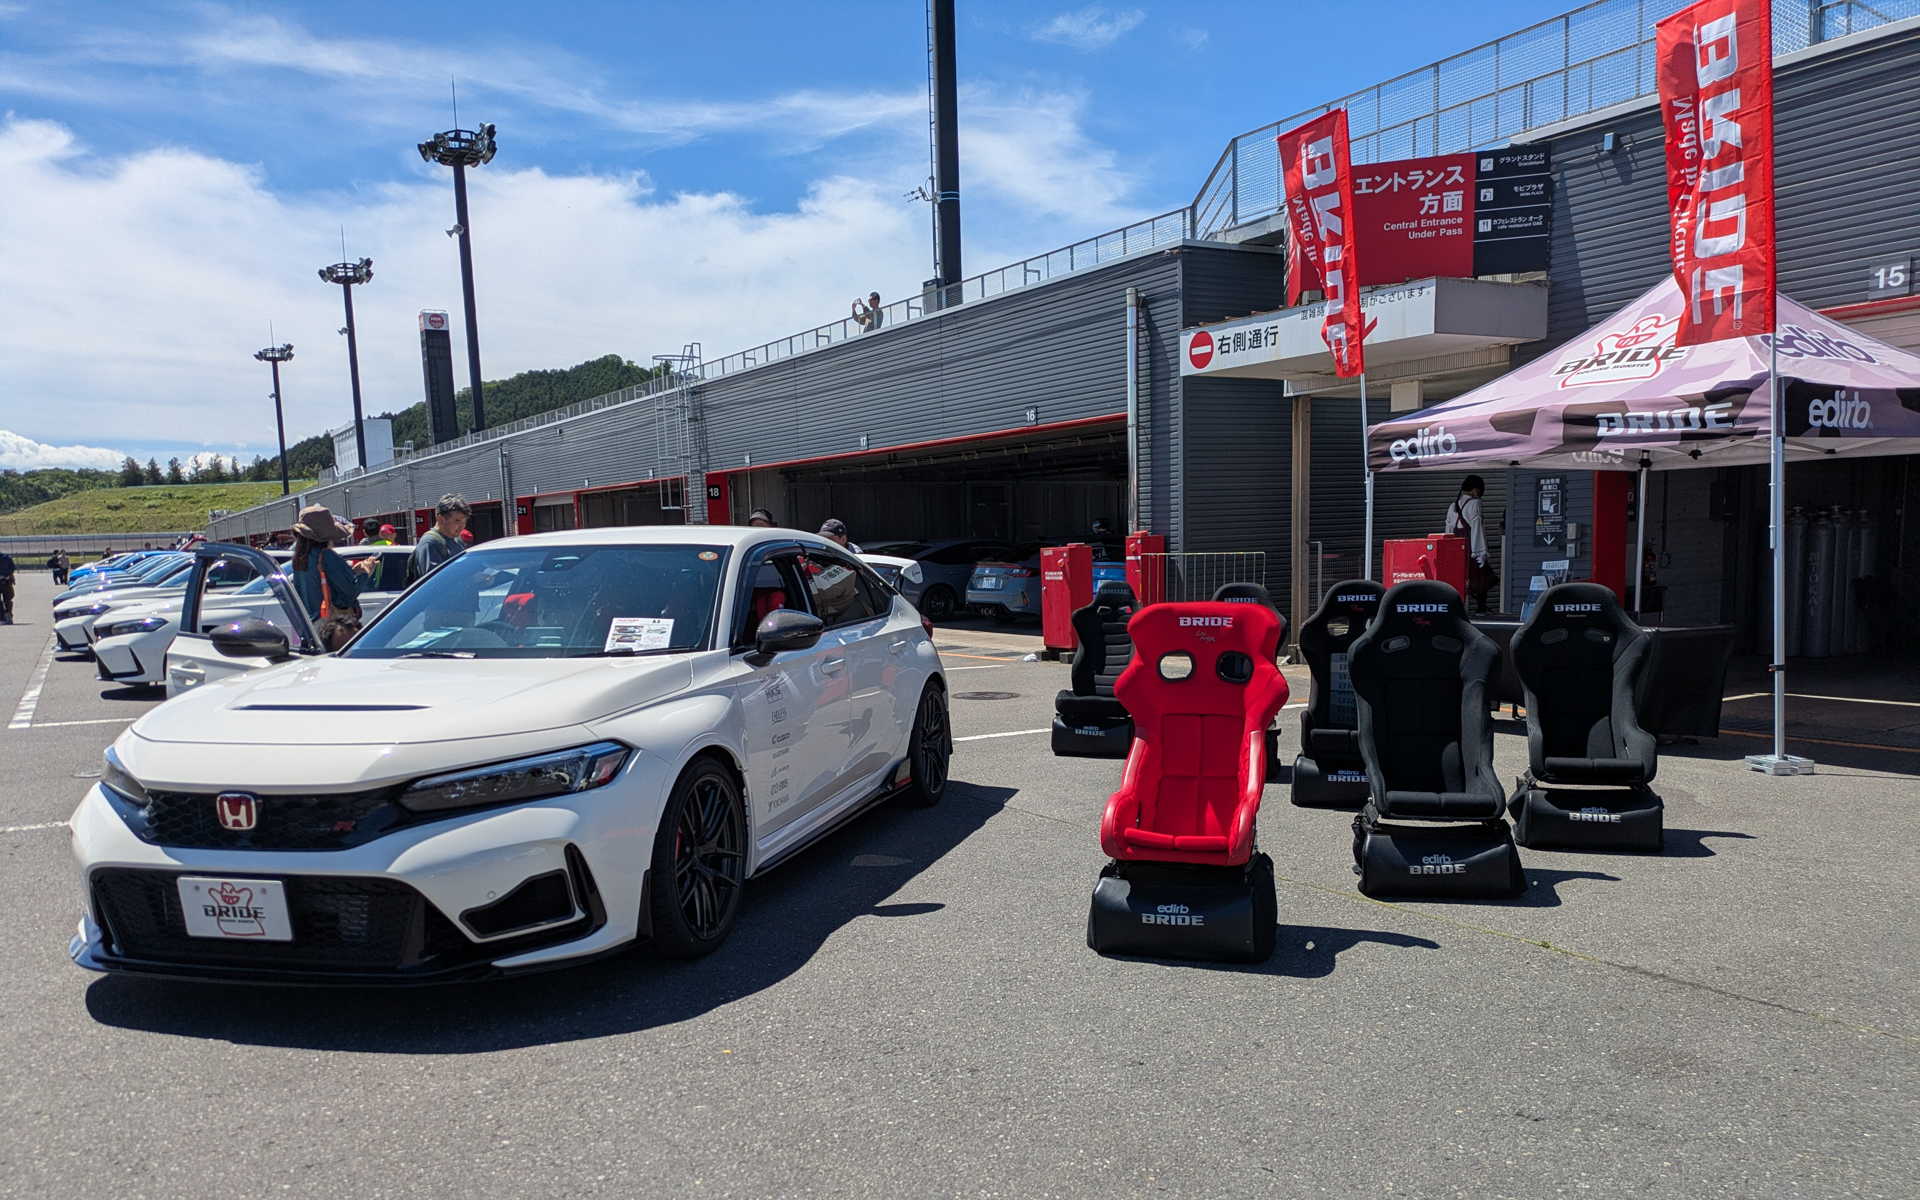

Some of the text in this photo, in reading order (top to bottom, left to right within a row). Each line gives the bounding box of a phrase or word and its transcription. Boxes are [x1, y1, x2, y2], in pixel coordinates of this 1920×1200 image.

[1499, 152, 1545, 164] グランドスタンド
[1354, 165, 1465, 195] エントランス
[1419, 191, 1463, 216] 方面
[1383, 216, 1463, 232] Central Entrance
[1492, 214, 1544, 226] カフェレストラン オーク
[1408, 226, 1463, 240] Under Pass
[1874, 265, 1905, 289] 15
[1217, 325, 1279, 356] 右側通行
[1554, 343, 1688, 375] BRIDE
[1611, 362, 1650, 370] MONSTER
[1808, 390, 1871, 429] edirb
[1026, 410, 1035, 422] 16
[1595, 402, 1733, 437] BRIDE
[860, 436, 867, 448] 17
[1389, 426, 1457, 461] edirb
[708, 487, 720, 497] 18
[1337, 594, 1376, 602] BRIDE
[1396, 603, 1449, 613] BRIDE
[1553, 603, 1602, 612] BRIDE
[1179, 616, 1233, 628] BRIDE
[1074, 728, 1106, 737] BRIDE
[1327, 774, 1369, 783] BRIDE
[1581, 806, 1608, 814] edirb
[1568, 812, 1622, 824] BRIDE
[1422, 854, 1452, 865] edirb
[1409, 863, 1467, 876] BRIDE
[202, 904, 266, 919] BRIDE
[1157, 903, 1189, 914] edirb
[1141, 913, 1204, 927] BRIDE
